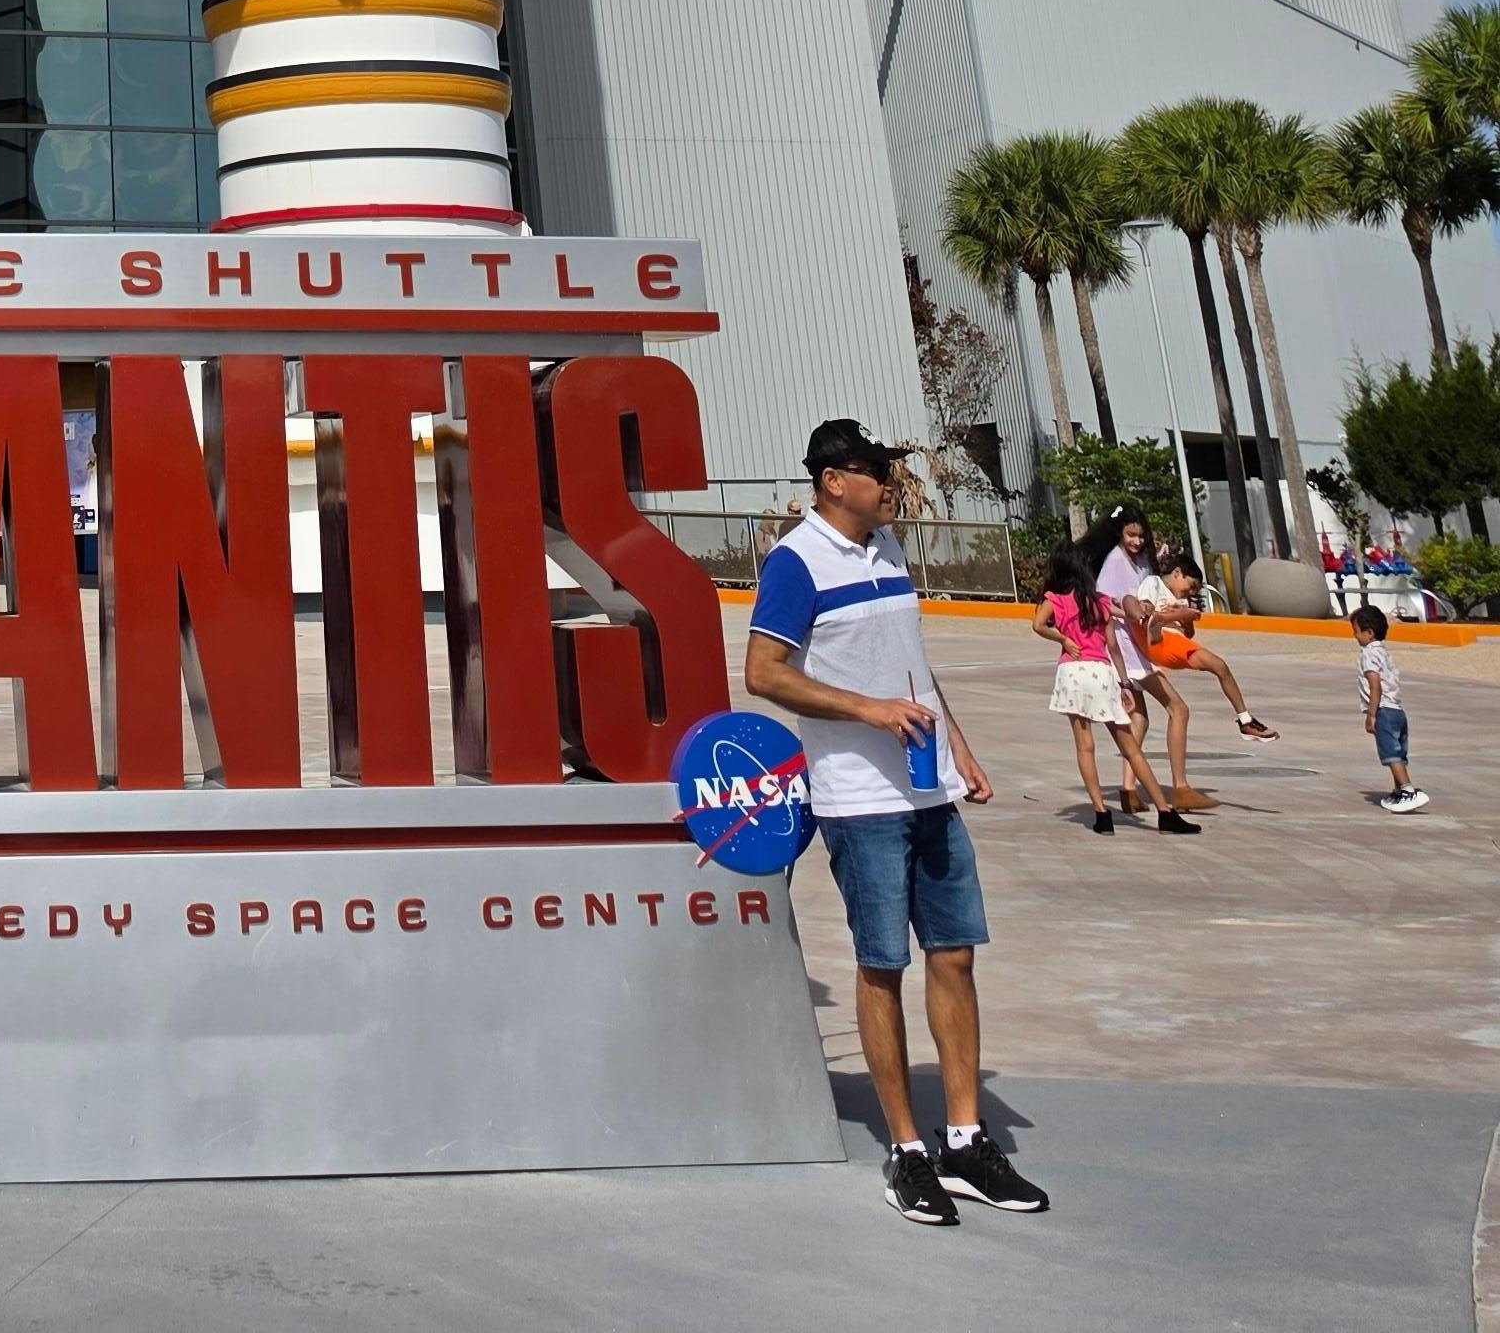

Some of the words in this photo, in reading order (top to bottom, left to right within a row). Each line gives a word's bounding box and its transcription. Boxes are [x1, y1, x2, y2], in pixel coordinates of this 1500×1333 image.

[120, 250, 681, 300] SHUTTLE
[693, 773, 811, 810] NASA
[186, 898, 428, 936] SPACE
[482, 890, 771, 929] CENTER
